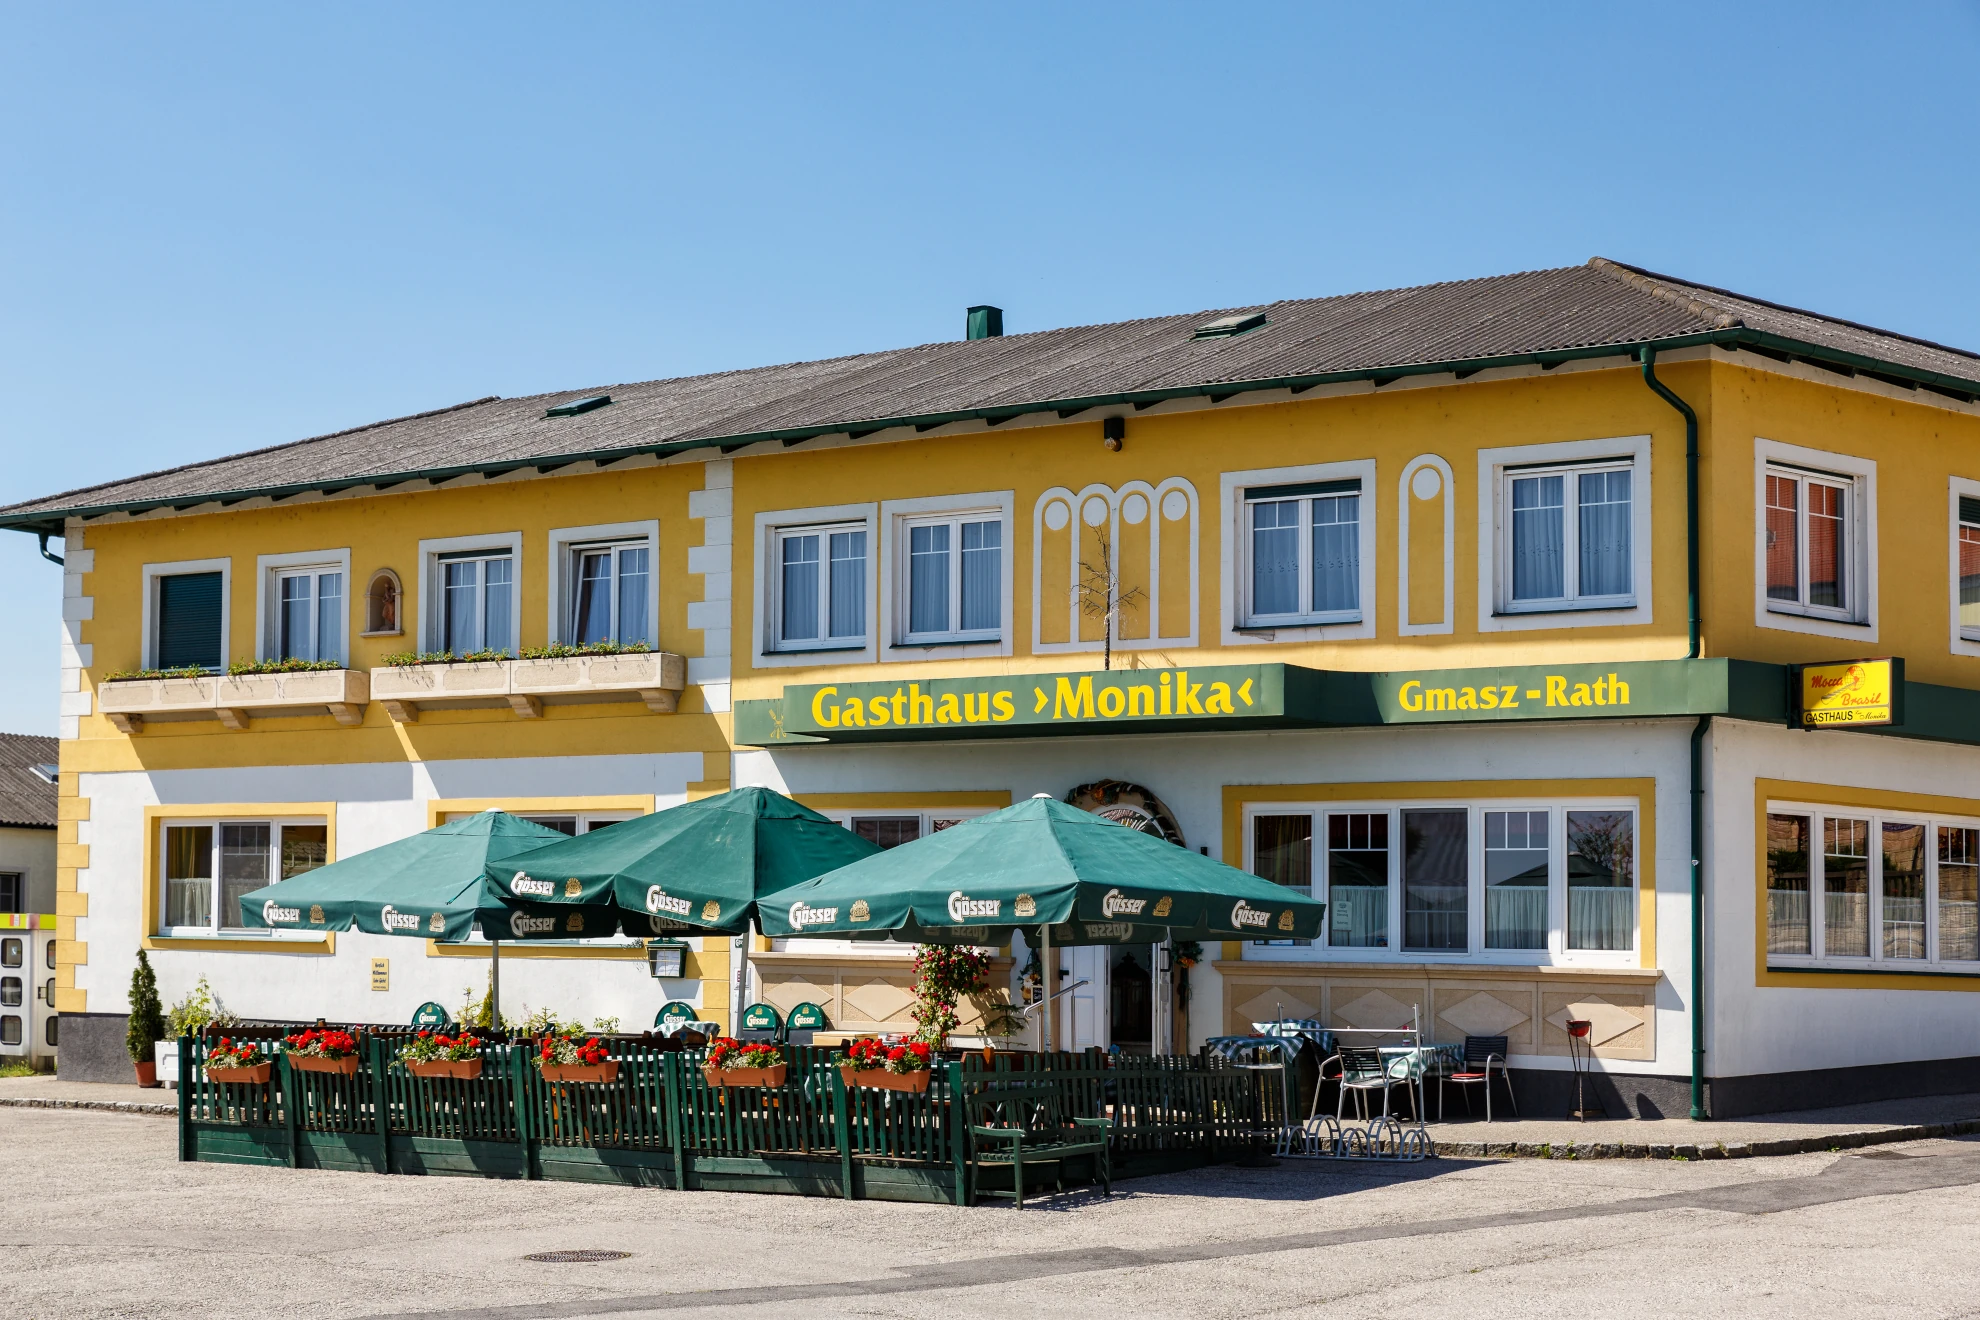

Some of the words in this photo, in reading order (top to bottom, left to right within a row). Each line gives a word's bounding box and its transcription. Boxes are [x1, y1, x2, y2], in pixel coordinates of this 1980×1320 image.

[1811, 675, 1843, 688] Mocca
[812, 683, 1015, 728] Gasthaus
[1841, 693, 1881, 706] Brasil
[1805, 711, 1854, 723] GASTHAUS
[510, 871, 556, 896] Gösser
[263, 899, 300, 926] Gösser
[646, 884, 692, 916] Gösser
[948, 890, 1001, 923] Gösser
[1102, 888, 1147, 918] Gösser
[382, 904, 420, 933] Gösser
[510, 910, 556, 937] Gösser
[788, 901, 838, 931] Gösser
[1231, 899, 1271, 929] Gösser
[747, 1014, 770, 1027] Gösser
[794, 1013, 816, 1027] Gösser
